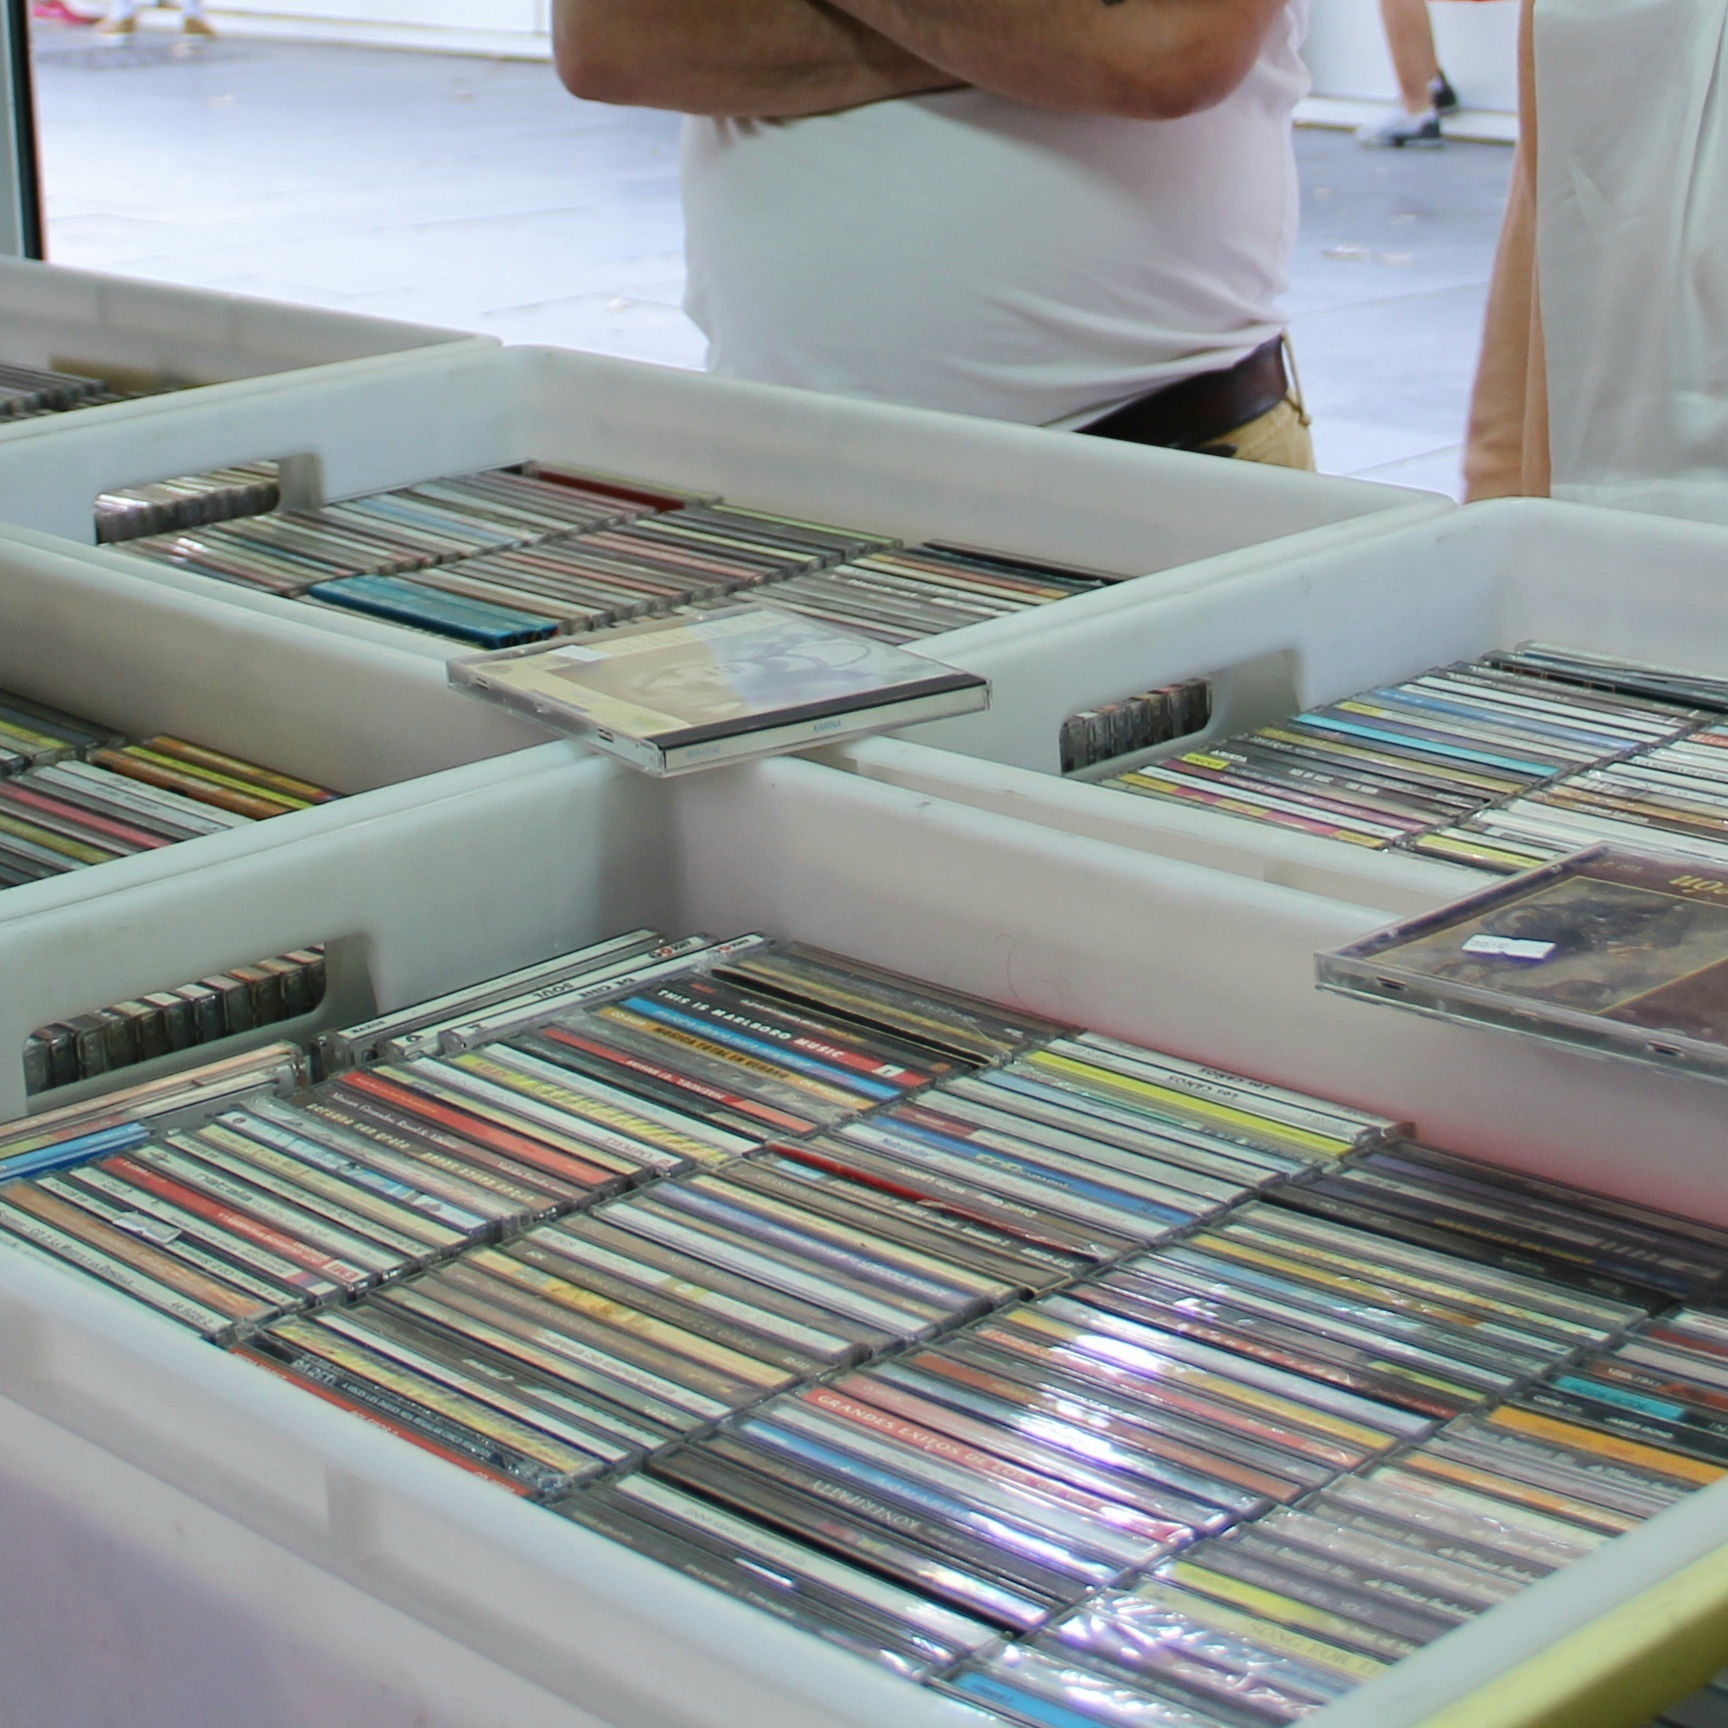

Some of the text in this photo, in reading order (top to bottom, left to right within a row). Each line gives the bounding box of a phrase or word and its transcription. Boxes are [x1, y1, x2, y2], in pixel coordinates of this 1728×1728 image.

[813, 719, 842, 733] KARINA
[532, 980, 574, 1002] SOUL
[576, 982, 610, 1001] CINE
[654, 988, 694, 1005] THIS
[689, 1000, 712, 1011] IS
[708, 1006, 796, 1041] MARLBORO
[790, 1036, 847, 1059] MUSIC
[671, 1077, 727, 1100] HAENDEL
[349, 1120, 381, 1136] non
[370, 1130, 415, 1151] grata
[599, 1135, 657, 1161] TIEMPO
[323, 1261, 362, 1280] EMI
[811, 1393, 1034, 1483] GRANDES EXITOS DE LOS
